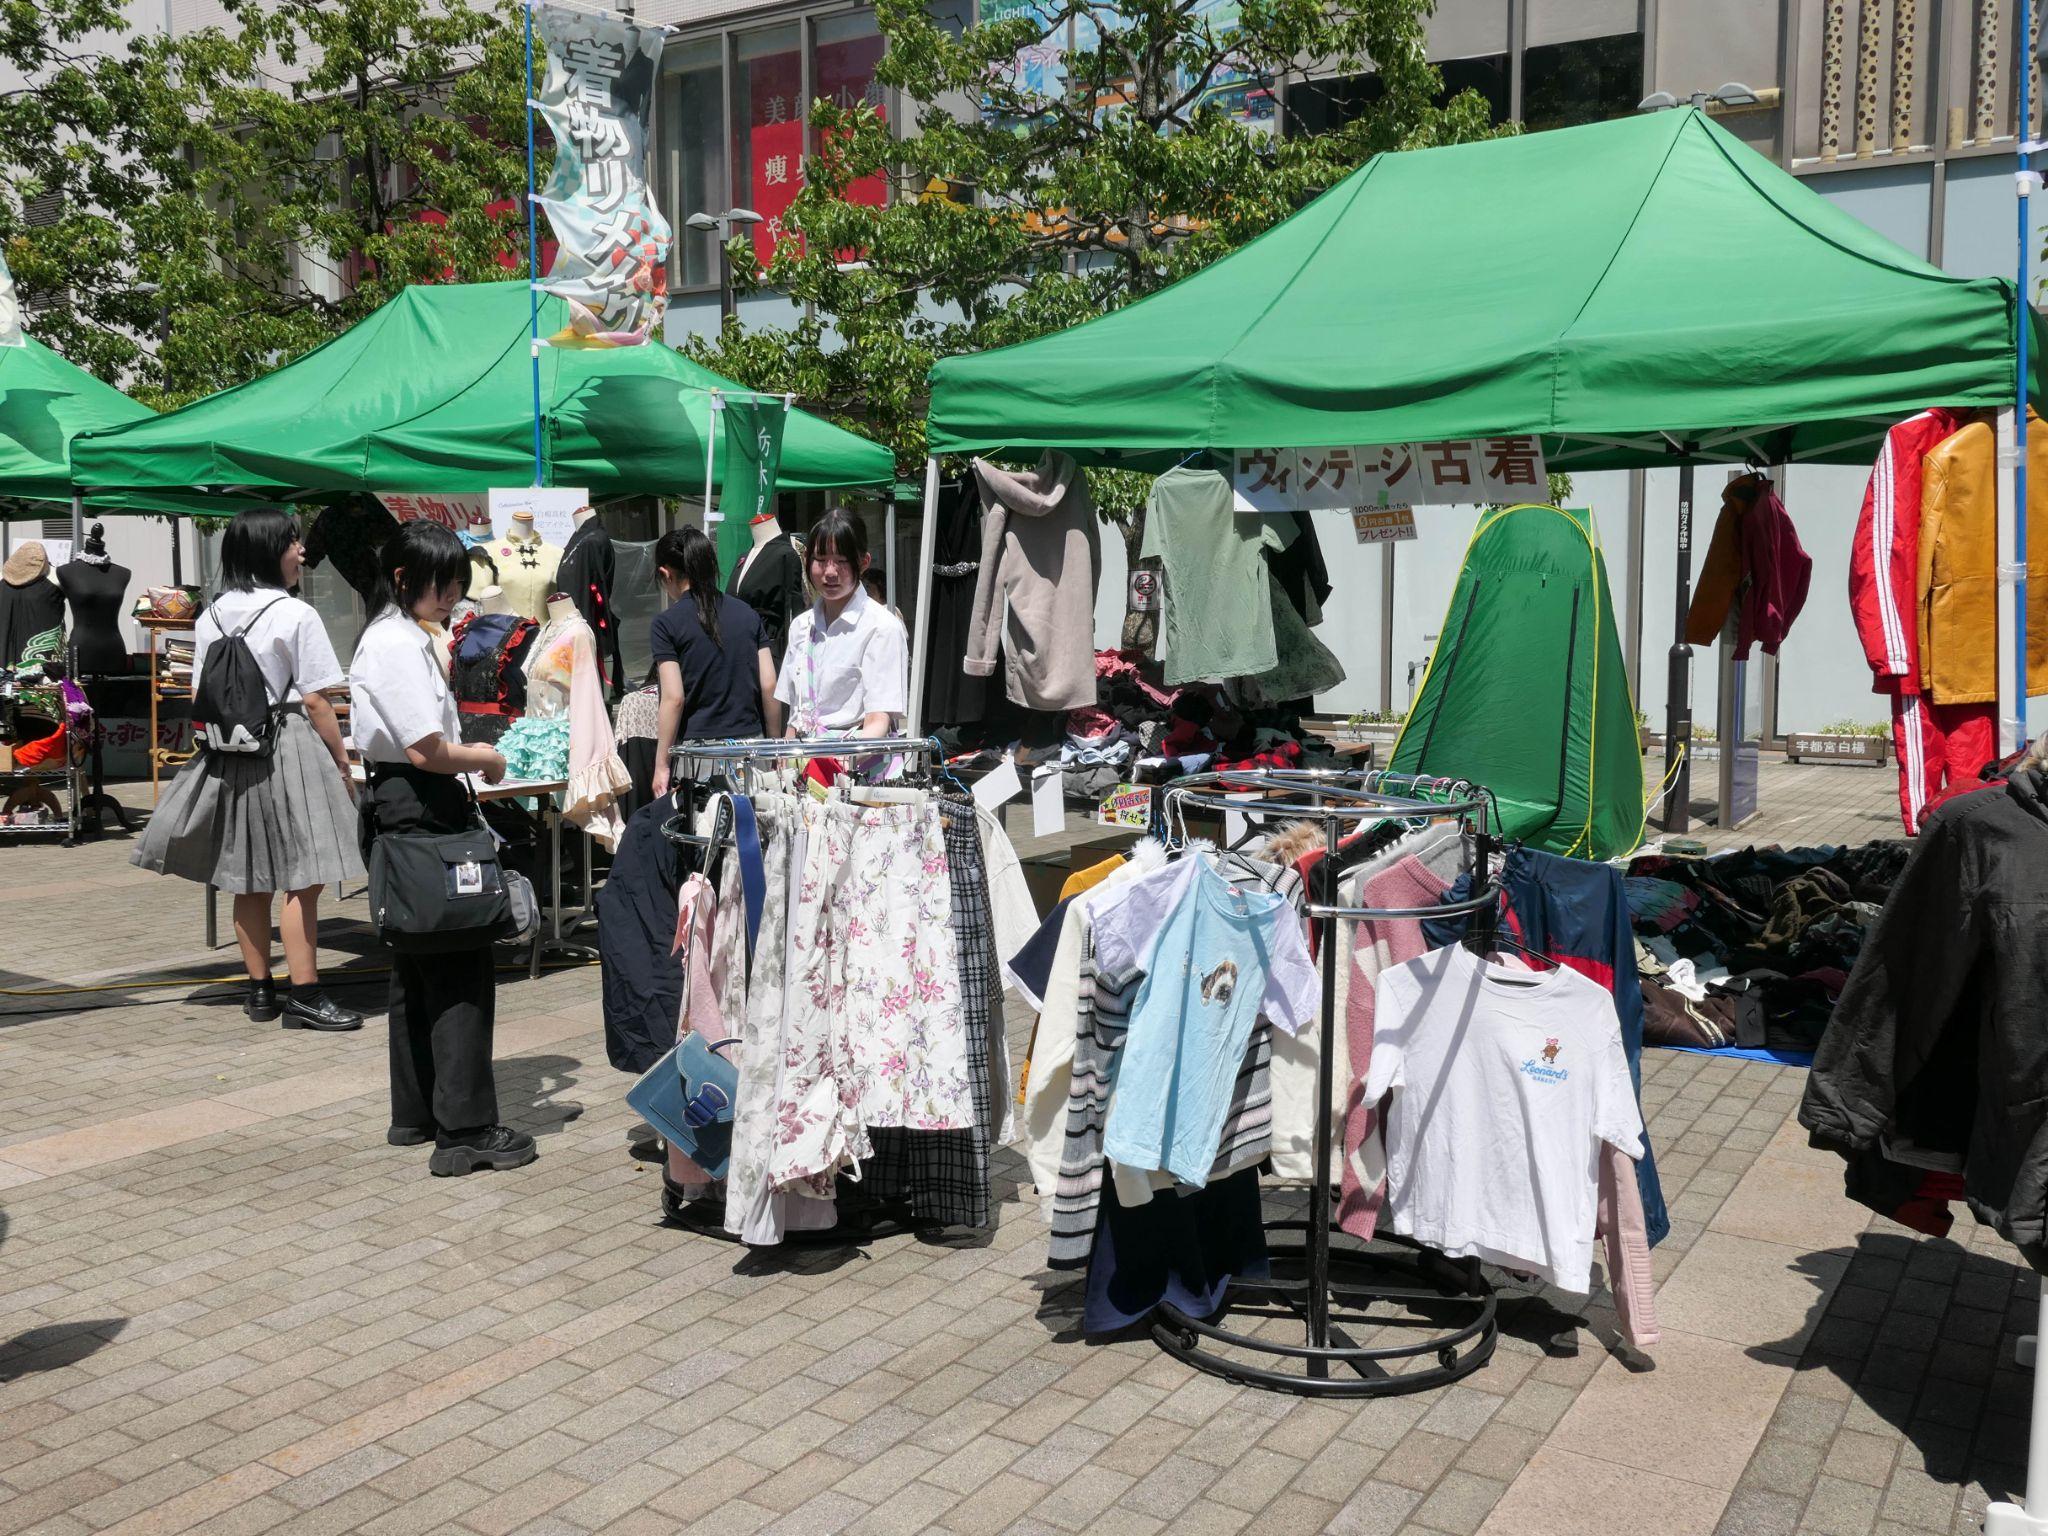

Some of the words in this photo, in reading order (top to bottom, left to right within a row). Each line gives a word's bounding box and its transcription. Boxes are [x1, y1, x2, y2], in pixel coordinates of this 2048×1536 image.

[562, 38, 642, 333] 着物リメイク
